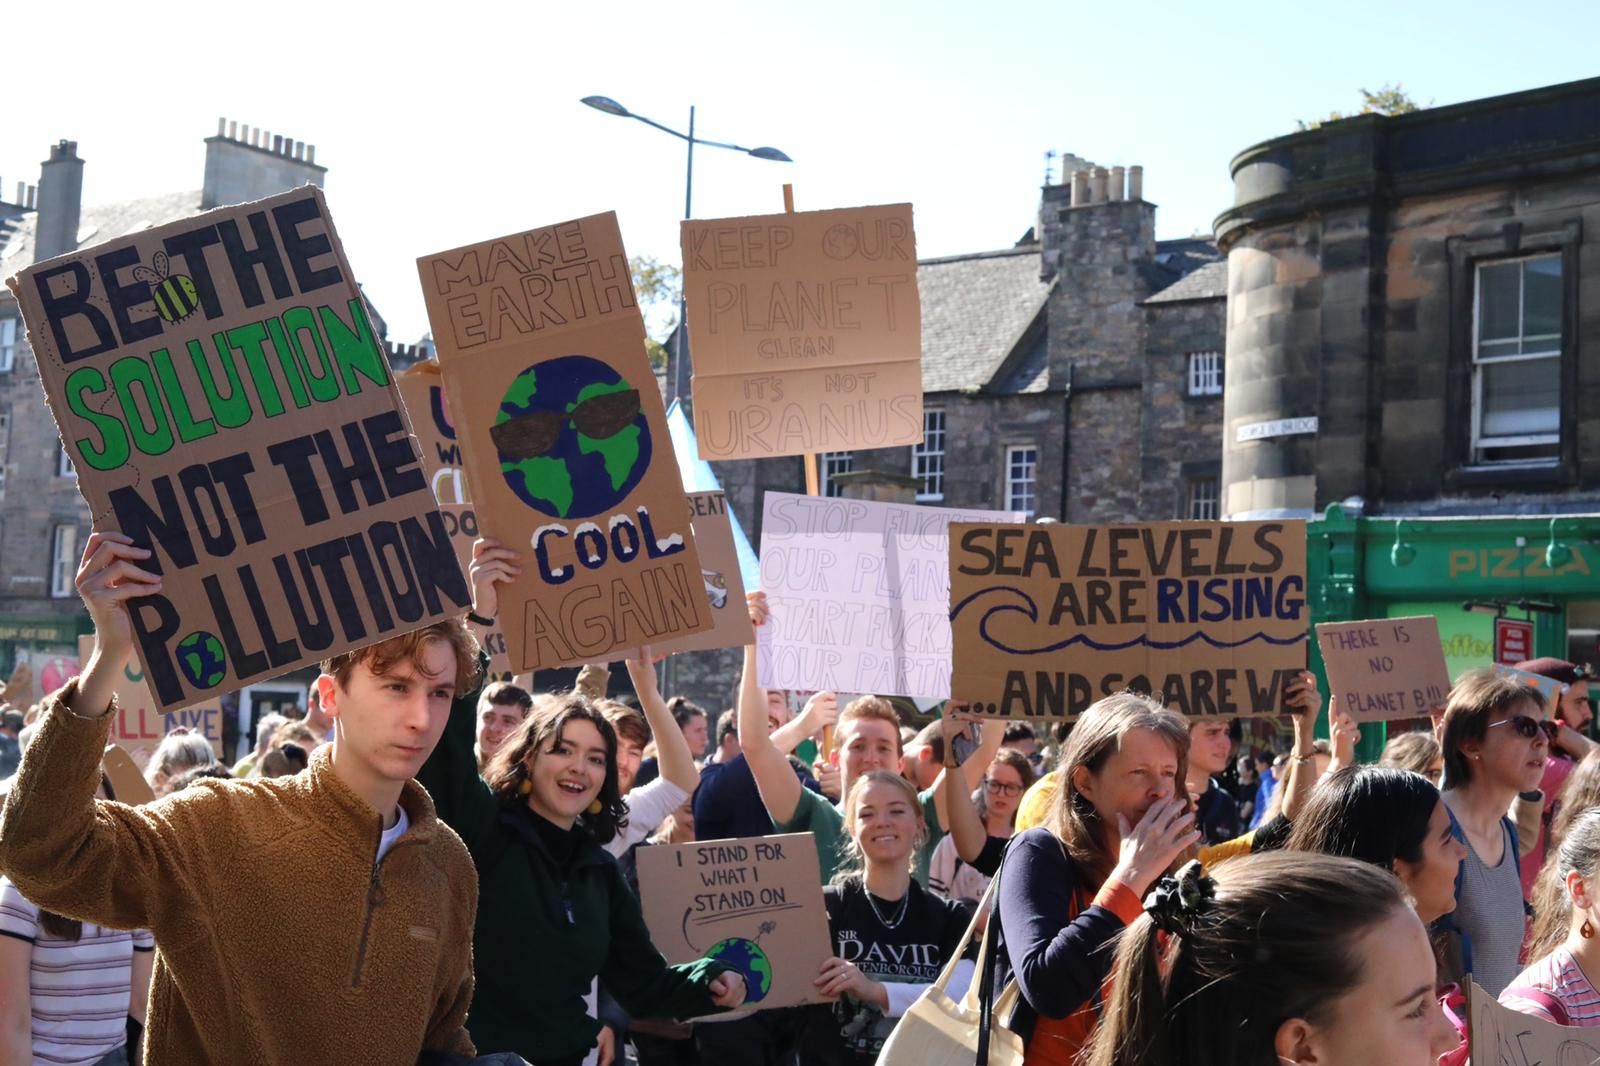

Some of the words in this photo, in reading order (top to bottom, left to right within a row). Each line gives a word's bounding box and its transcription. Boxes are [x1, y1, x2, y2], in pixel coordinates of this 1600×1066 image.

[431, 220, 588, 295] MAKE
[688, 224, 794, 272] KEEP
[821, 216, 910, 262] OUR
[33, 245, 164, 365] BE
[163, 197, 344, 320] THE
[447, 254, 636, 349] EARTH
[707, 273, 909, 335] PLANET
[757, 336, 835, 361] CLEAN
[64, 297, 391, 471] SOLUTION
[743, 376, 784, 402] IT'S
[825, 372, 877, 395] NOT
[702, 394, 923, 456] URANUS
[108, 452, 267, 576] NOT
[267, 410, 428, 526] THE
[767, 497, 867, 542] STOP
[530, 505, 685, 585] COOL
[958, 528, 1061, 578] SEA
[1077, 523, 1283, 578] LEVELS
[1450, 547, 1591, 578] PIZZA
[762, 546, 837, 592] OUR
[851, 552, 950, 600] PLAN
[522, 563, 700, 670] AGAIN
[760, 596, 864, 646] START
[1049, 580, 1147, 626] ARE
[1157, 575, 1305, 623] RISING
[1323, 629, 1379, 651] THERE
[1394, 625, 1411, 644] IS
[760, 643, 842, 692] YOUR
[1368, 656, 1394, 674] NO
[1162, 669, 1237, 716] ARE
[1346, 690, 1409, 714] PLANET
[676, 850, 683, 868] I
[697, 844, 749, 866] STAND
[755, 843, 786, 862] FOR
[700, 867, 748, 887] WHAT
[753, 866, 759, 883] I
[694, 889, 755, 913] STAND
[760, 887, 786, 905] ON
[838, 930, 858, 940] SIR
[838, 940, 941, 967] DAVID
[855, 961, 939, 978] TENBOROUG
